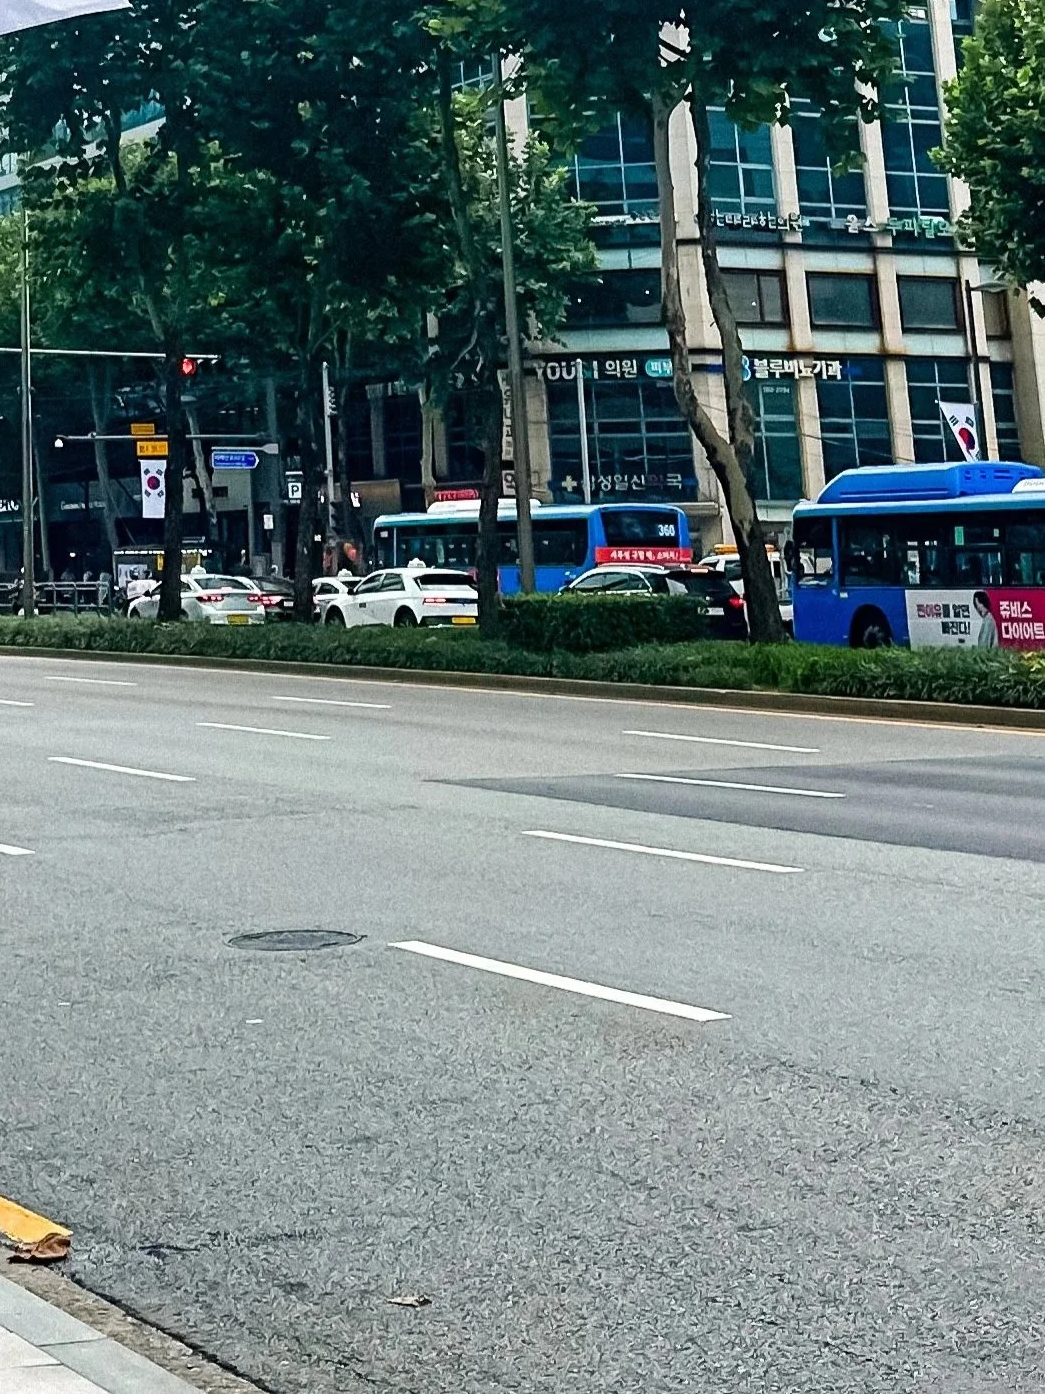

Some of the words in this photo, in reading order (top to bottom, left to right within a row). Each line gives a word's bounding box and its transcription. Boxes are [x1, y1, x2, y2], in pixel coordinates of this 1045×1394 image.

[605, 358, 638, 379] 의원
[753, 358, 843, 380] 블루비뇨기과
[658, 524, 676, 537] 360
[999, 600, 1033, 619] 쥬비스
[1001, 621, 1045, 640] 다이어트
